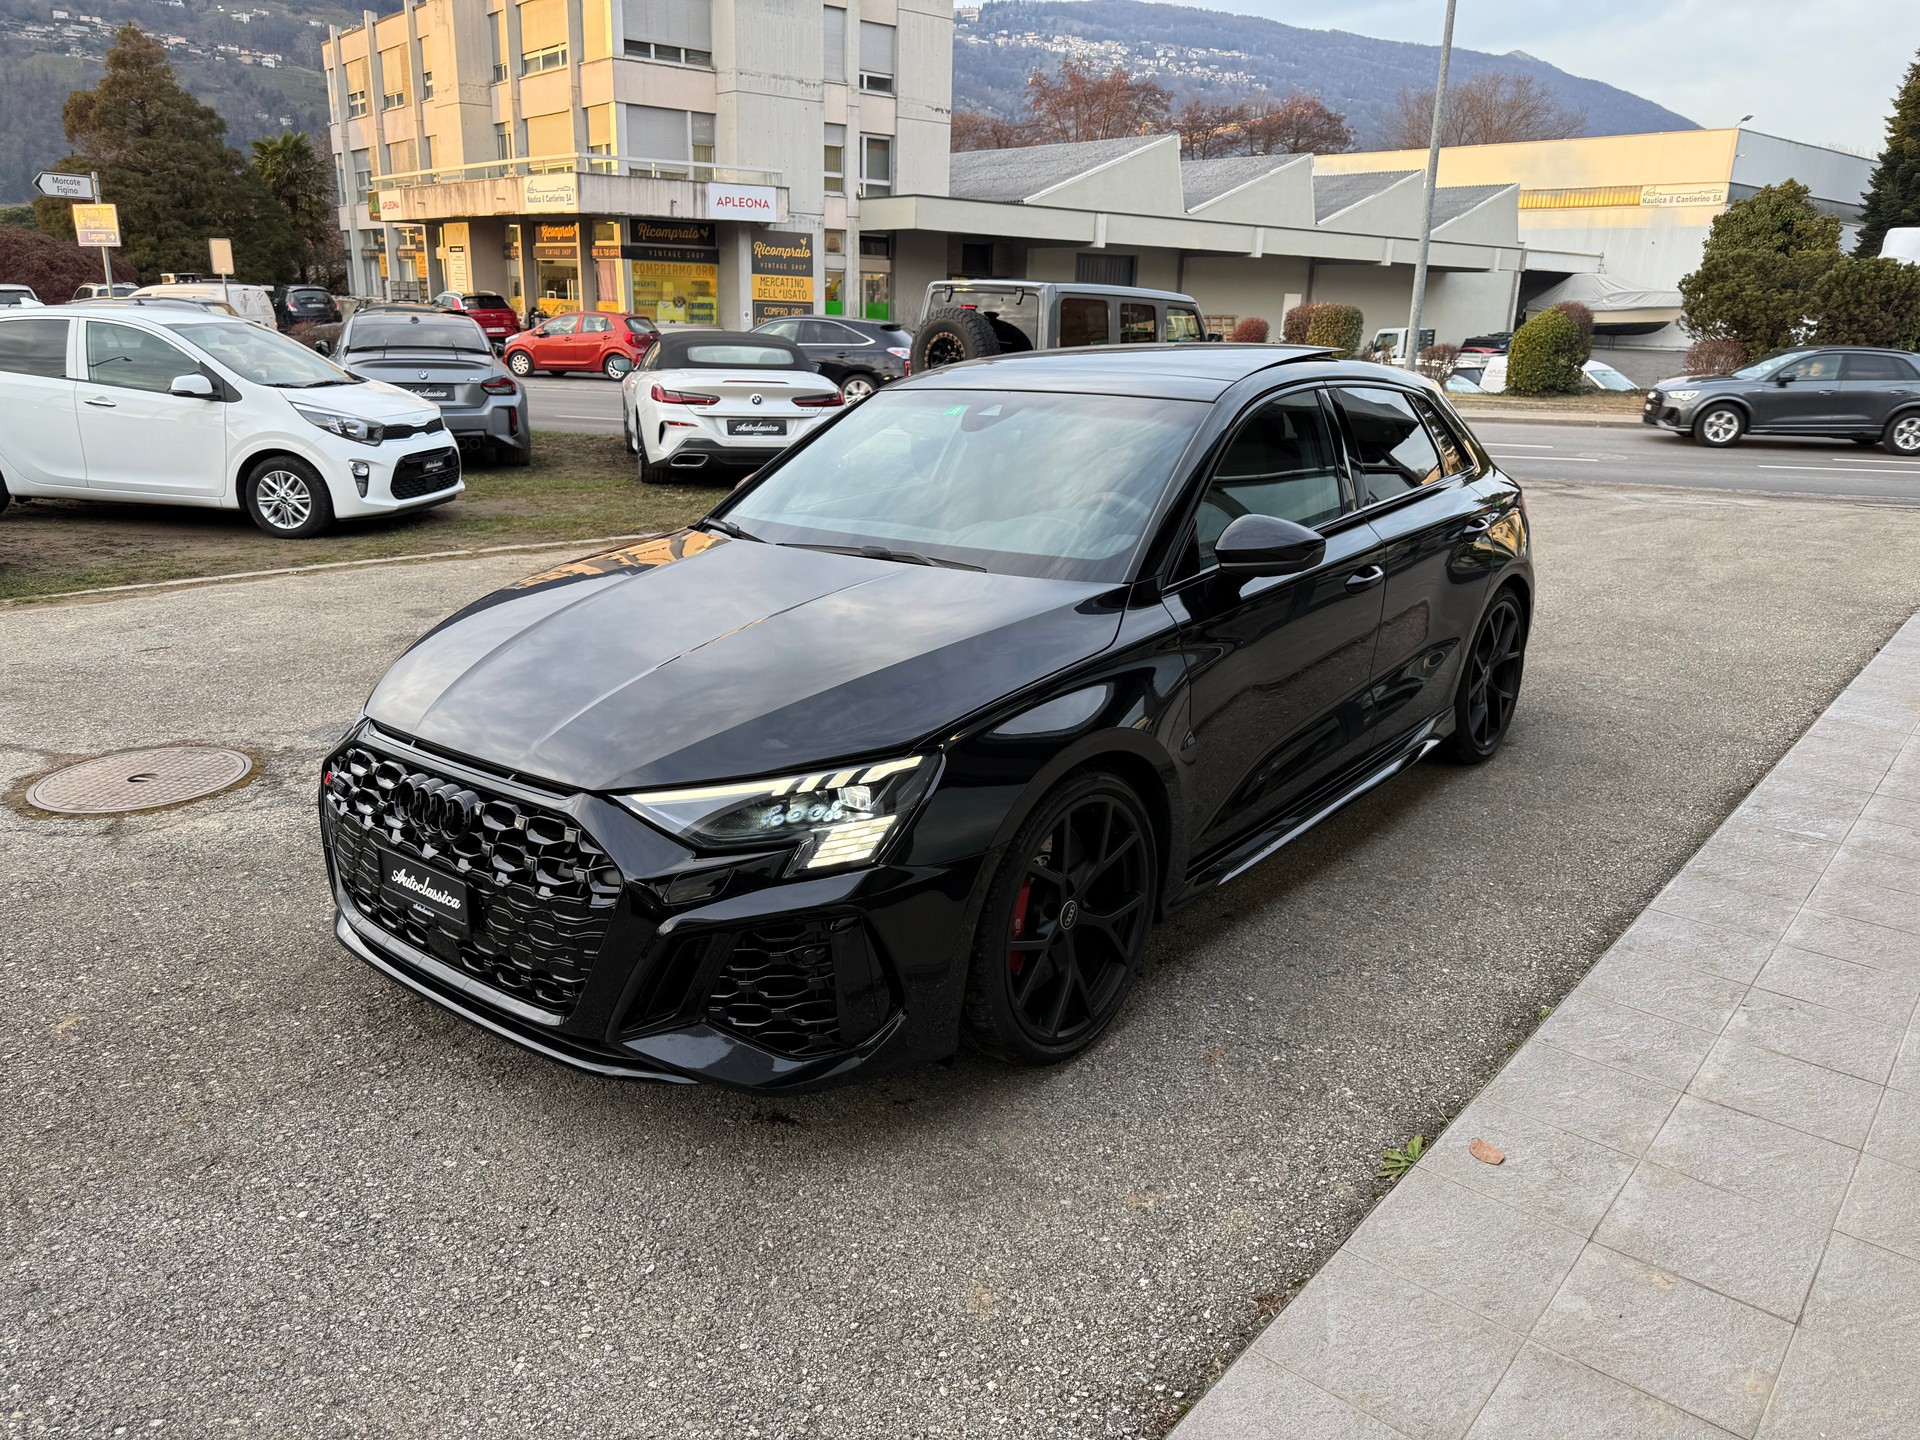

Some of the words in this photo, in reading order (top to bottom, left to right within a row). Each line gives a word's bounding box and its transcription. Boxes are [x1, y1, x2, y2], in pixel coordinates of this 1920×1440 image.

[52, 176, 81, 186] Morcote
[57, 185, 79, 195] Figino
[716, 196, 770, 209] APLEONA
[1676, 195, 1711, 203] Cantierino
[1713, 194, 1723, 202] SA
[88, 232, 107, 242] Lugano
[637, 223, 701, 241] Ricompralo
[648, 249, 682, 258] VINTAGE
[686, 251, 705, 260] SHOP
[754, 241, 811, 259] Ricompralo
[633, 262, 692, 276] COMPRIAMO
[695, 265, 715, 277] ORO
[760, 262, 787, 270] VINTAGE
[791, 263, 806, 271] SHOP
[760, 277, 805, 288] MERCATINO
[758, 288, 808, 300] DELL'USATO
[764, 307, 788, 316] COMPRO
[791, 308, 804, 316] ORO
[735, 422, 780, 432] Autoclassica
[391, 868, 461, 910] Autoclassica
